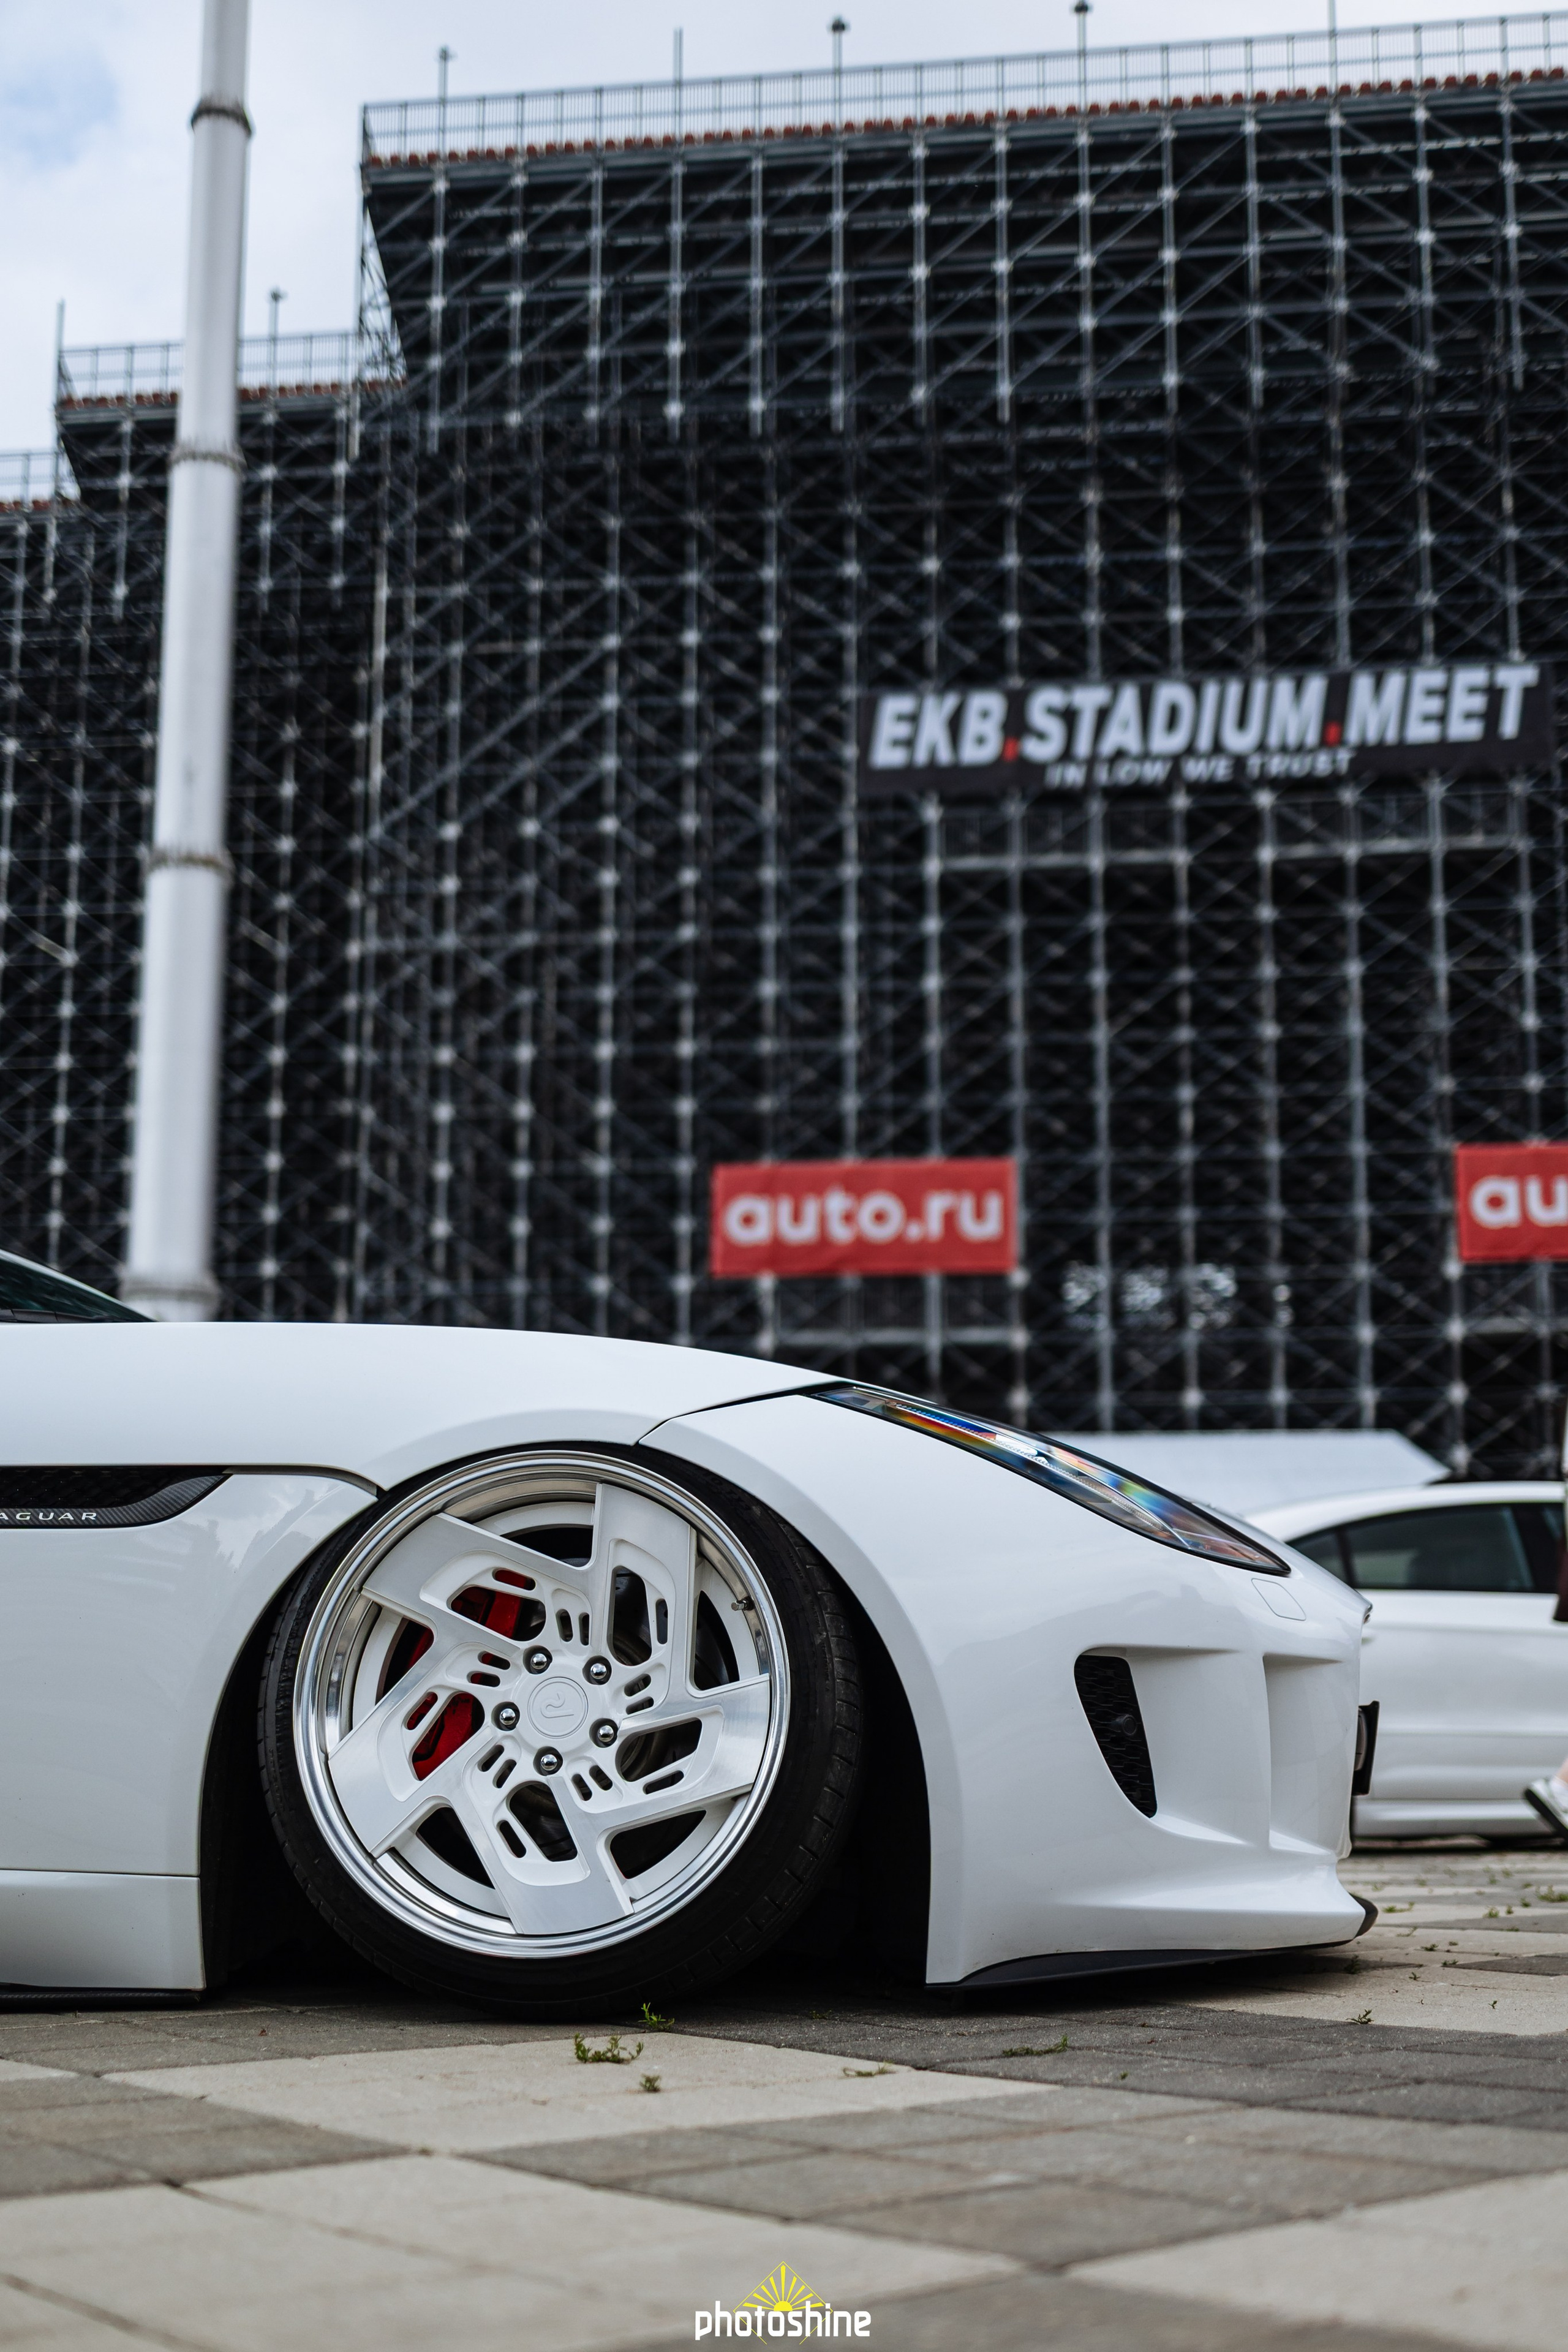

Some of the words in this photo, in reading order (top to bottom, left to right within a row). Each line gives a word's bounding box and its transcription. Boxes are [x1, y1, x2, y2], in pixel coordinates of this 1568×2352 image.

[1044, 761, 1087, 790] IN
[1093, 757, 1172, 787] LOW
[1179, 753, 1235, 783] WE
[1246, 747, 1355, 780] TRUST
[724, 1184, 1003, 1246] auto.ru
